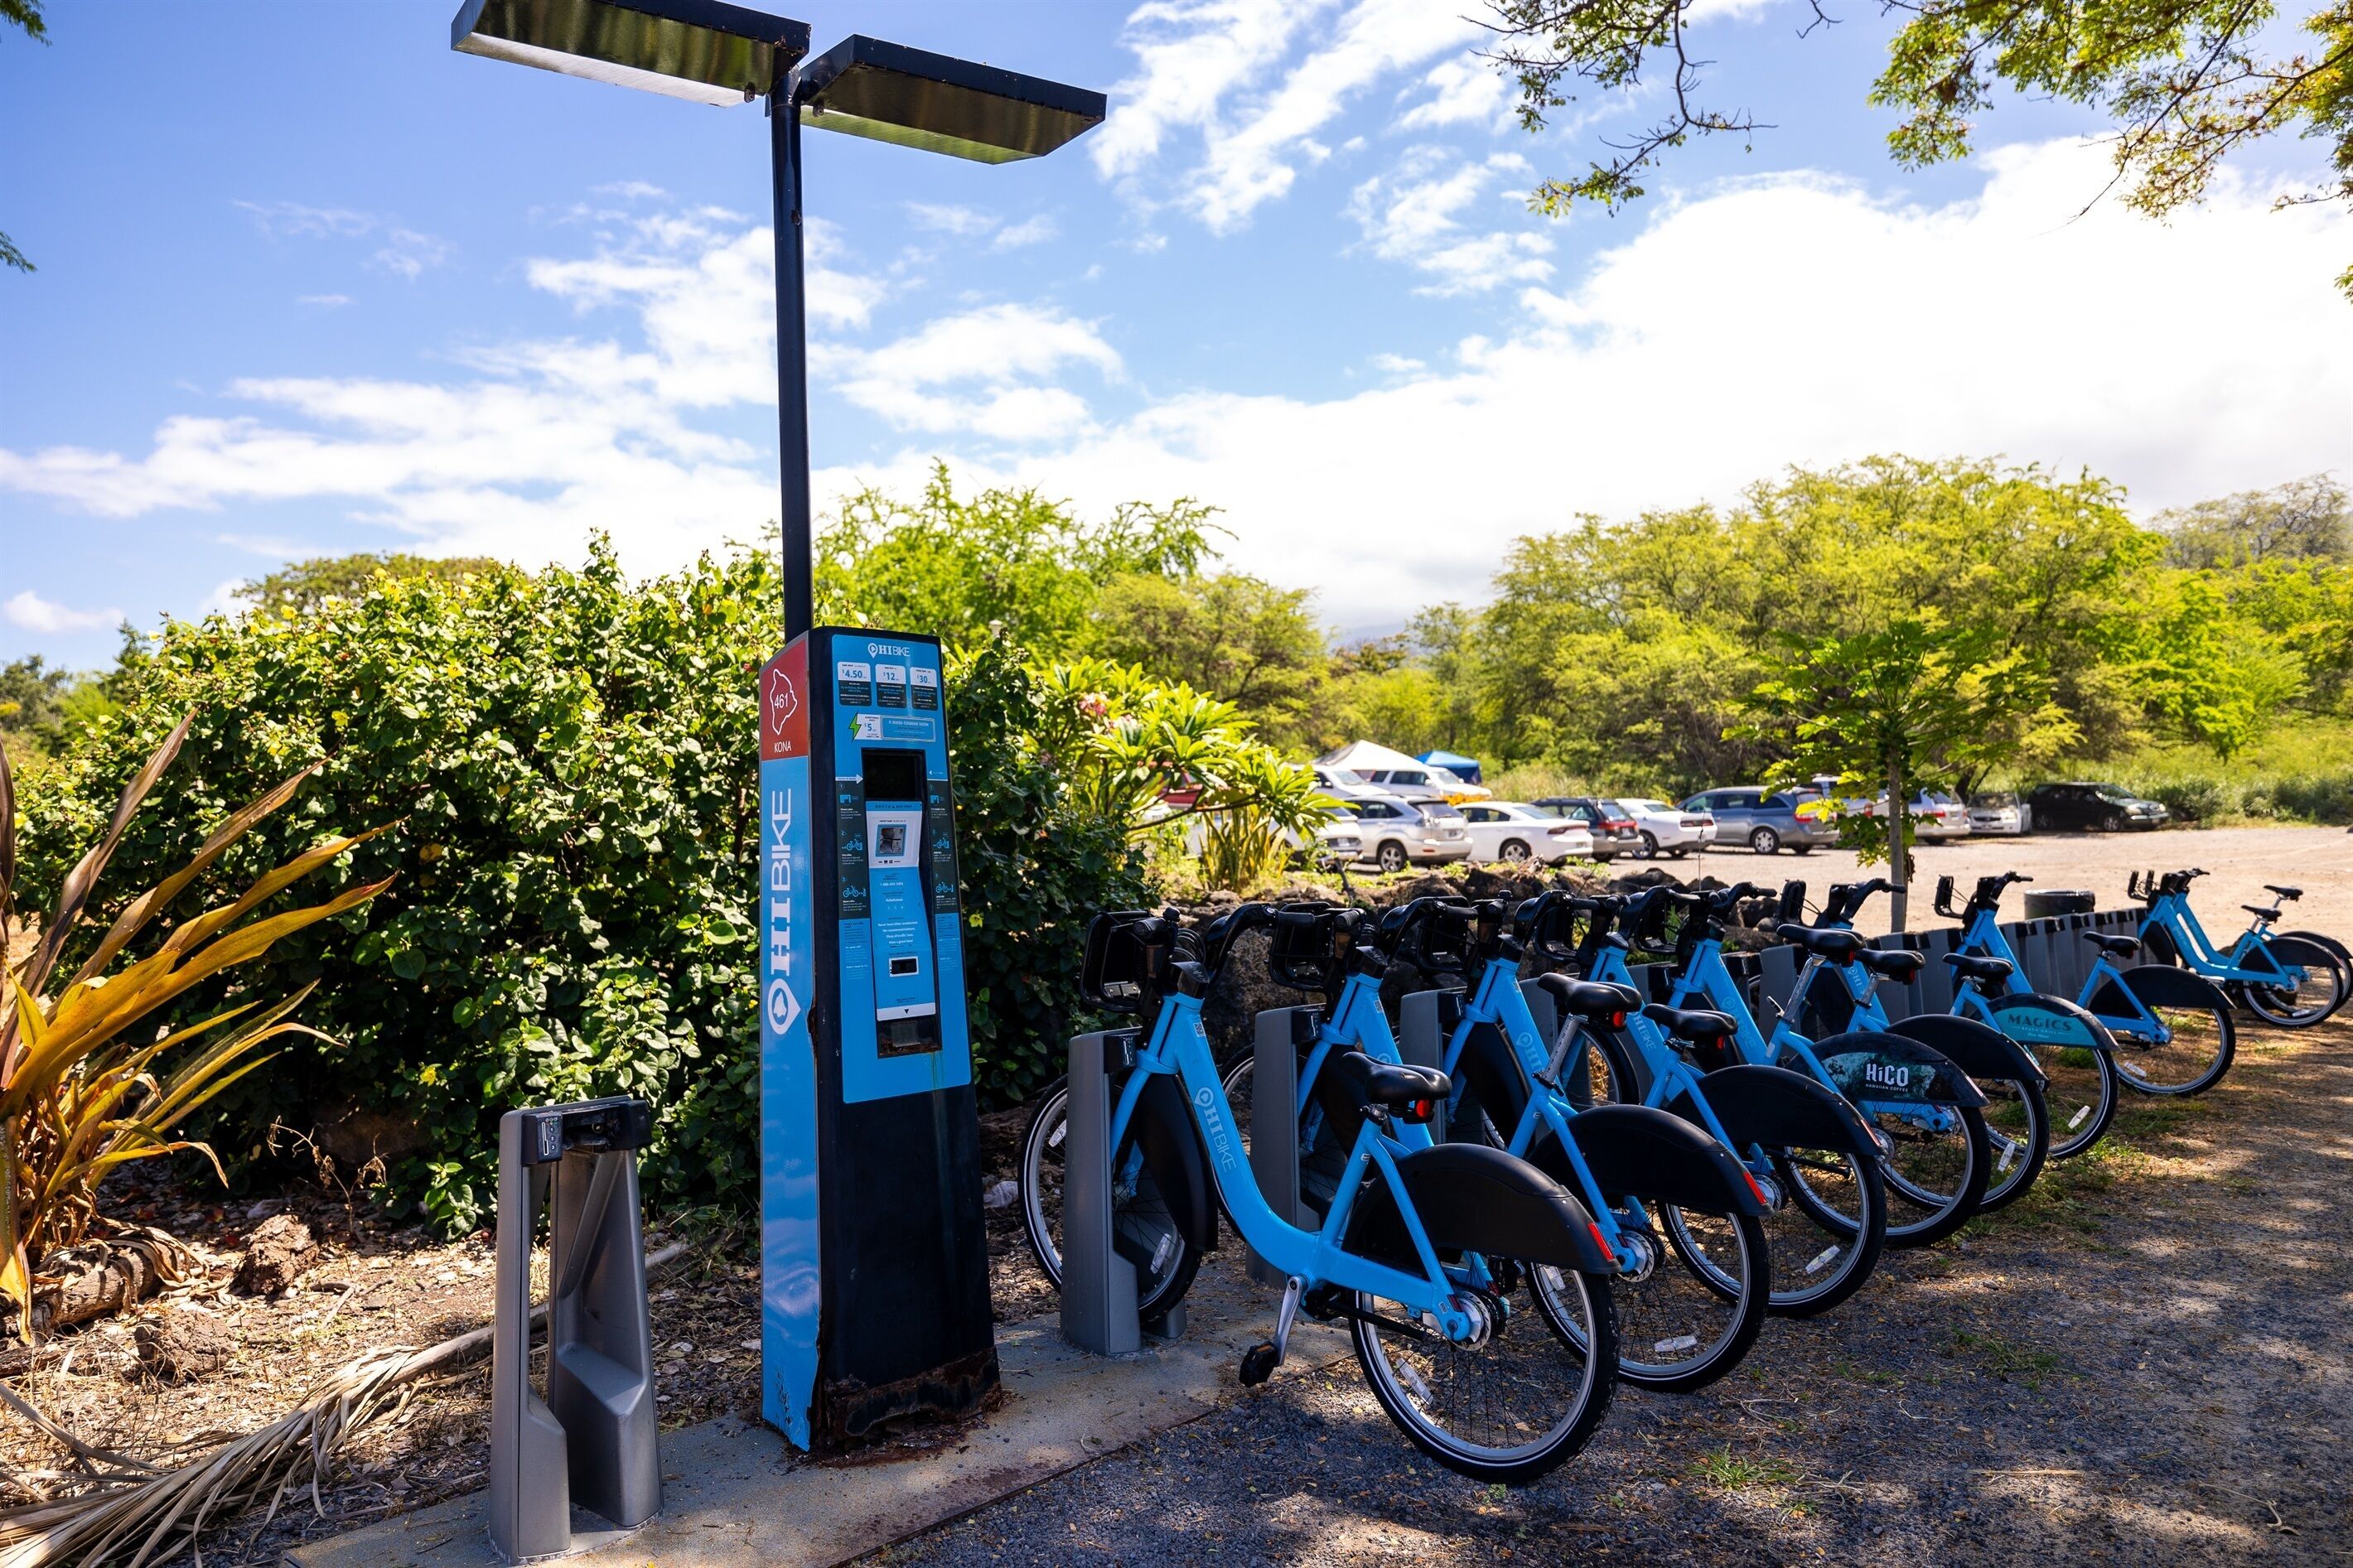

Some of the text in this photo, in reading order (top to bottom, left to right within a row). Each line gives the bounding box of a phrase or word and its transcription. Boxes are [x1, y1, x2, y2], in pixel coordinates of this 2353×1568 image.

[774, 692, 788, 709] 461
[774, 741, 792, 753] KONA
[2008, 1013, 2072, 1031] MAGICS
